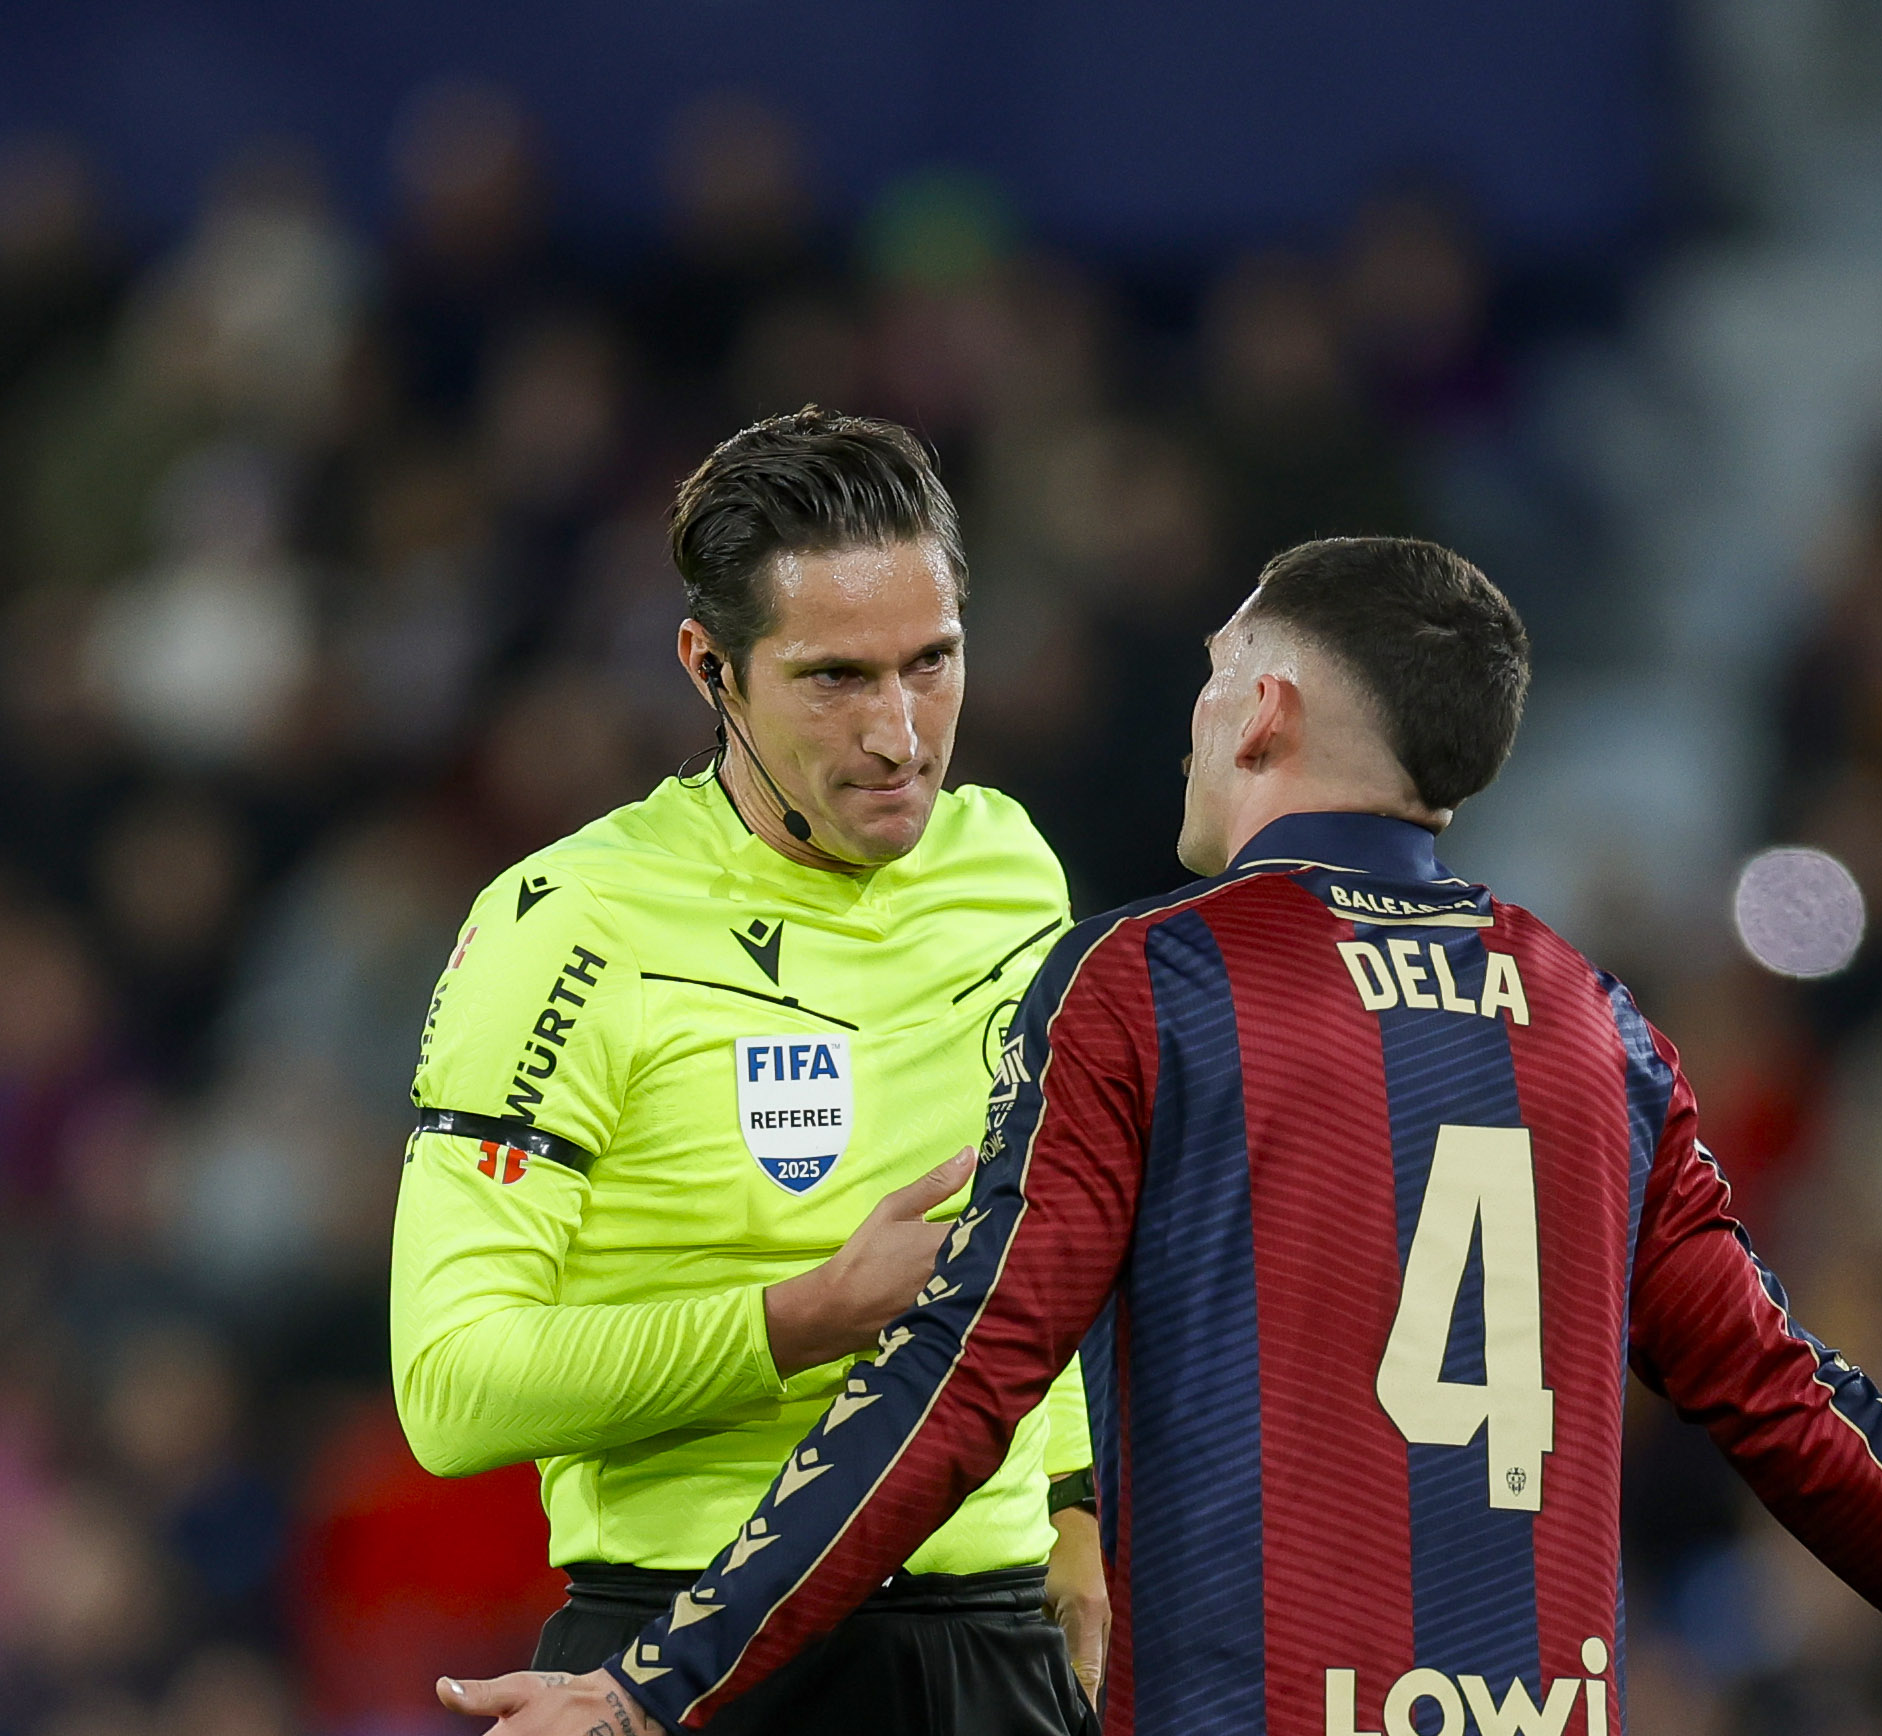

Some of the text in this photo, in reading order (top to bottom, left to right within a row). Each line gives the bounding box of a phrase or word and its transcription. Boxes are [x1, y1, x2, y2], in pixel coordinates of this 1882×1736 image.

[1336, 938, 1530, 1026] DELA
[500, 944, 608, 1126] WÜRTH
[747, 1044, 840, 1083] FIFA
[750, 1108, 842, 1129] REFEREE
[777, 1160, 820, 1179] 2025
[1375, 1123, 1555, 1512] 4
